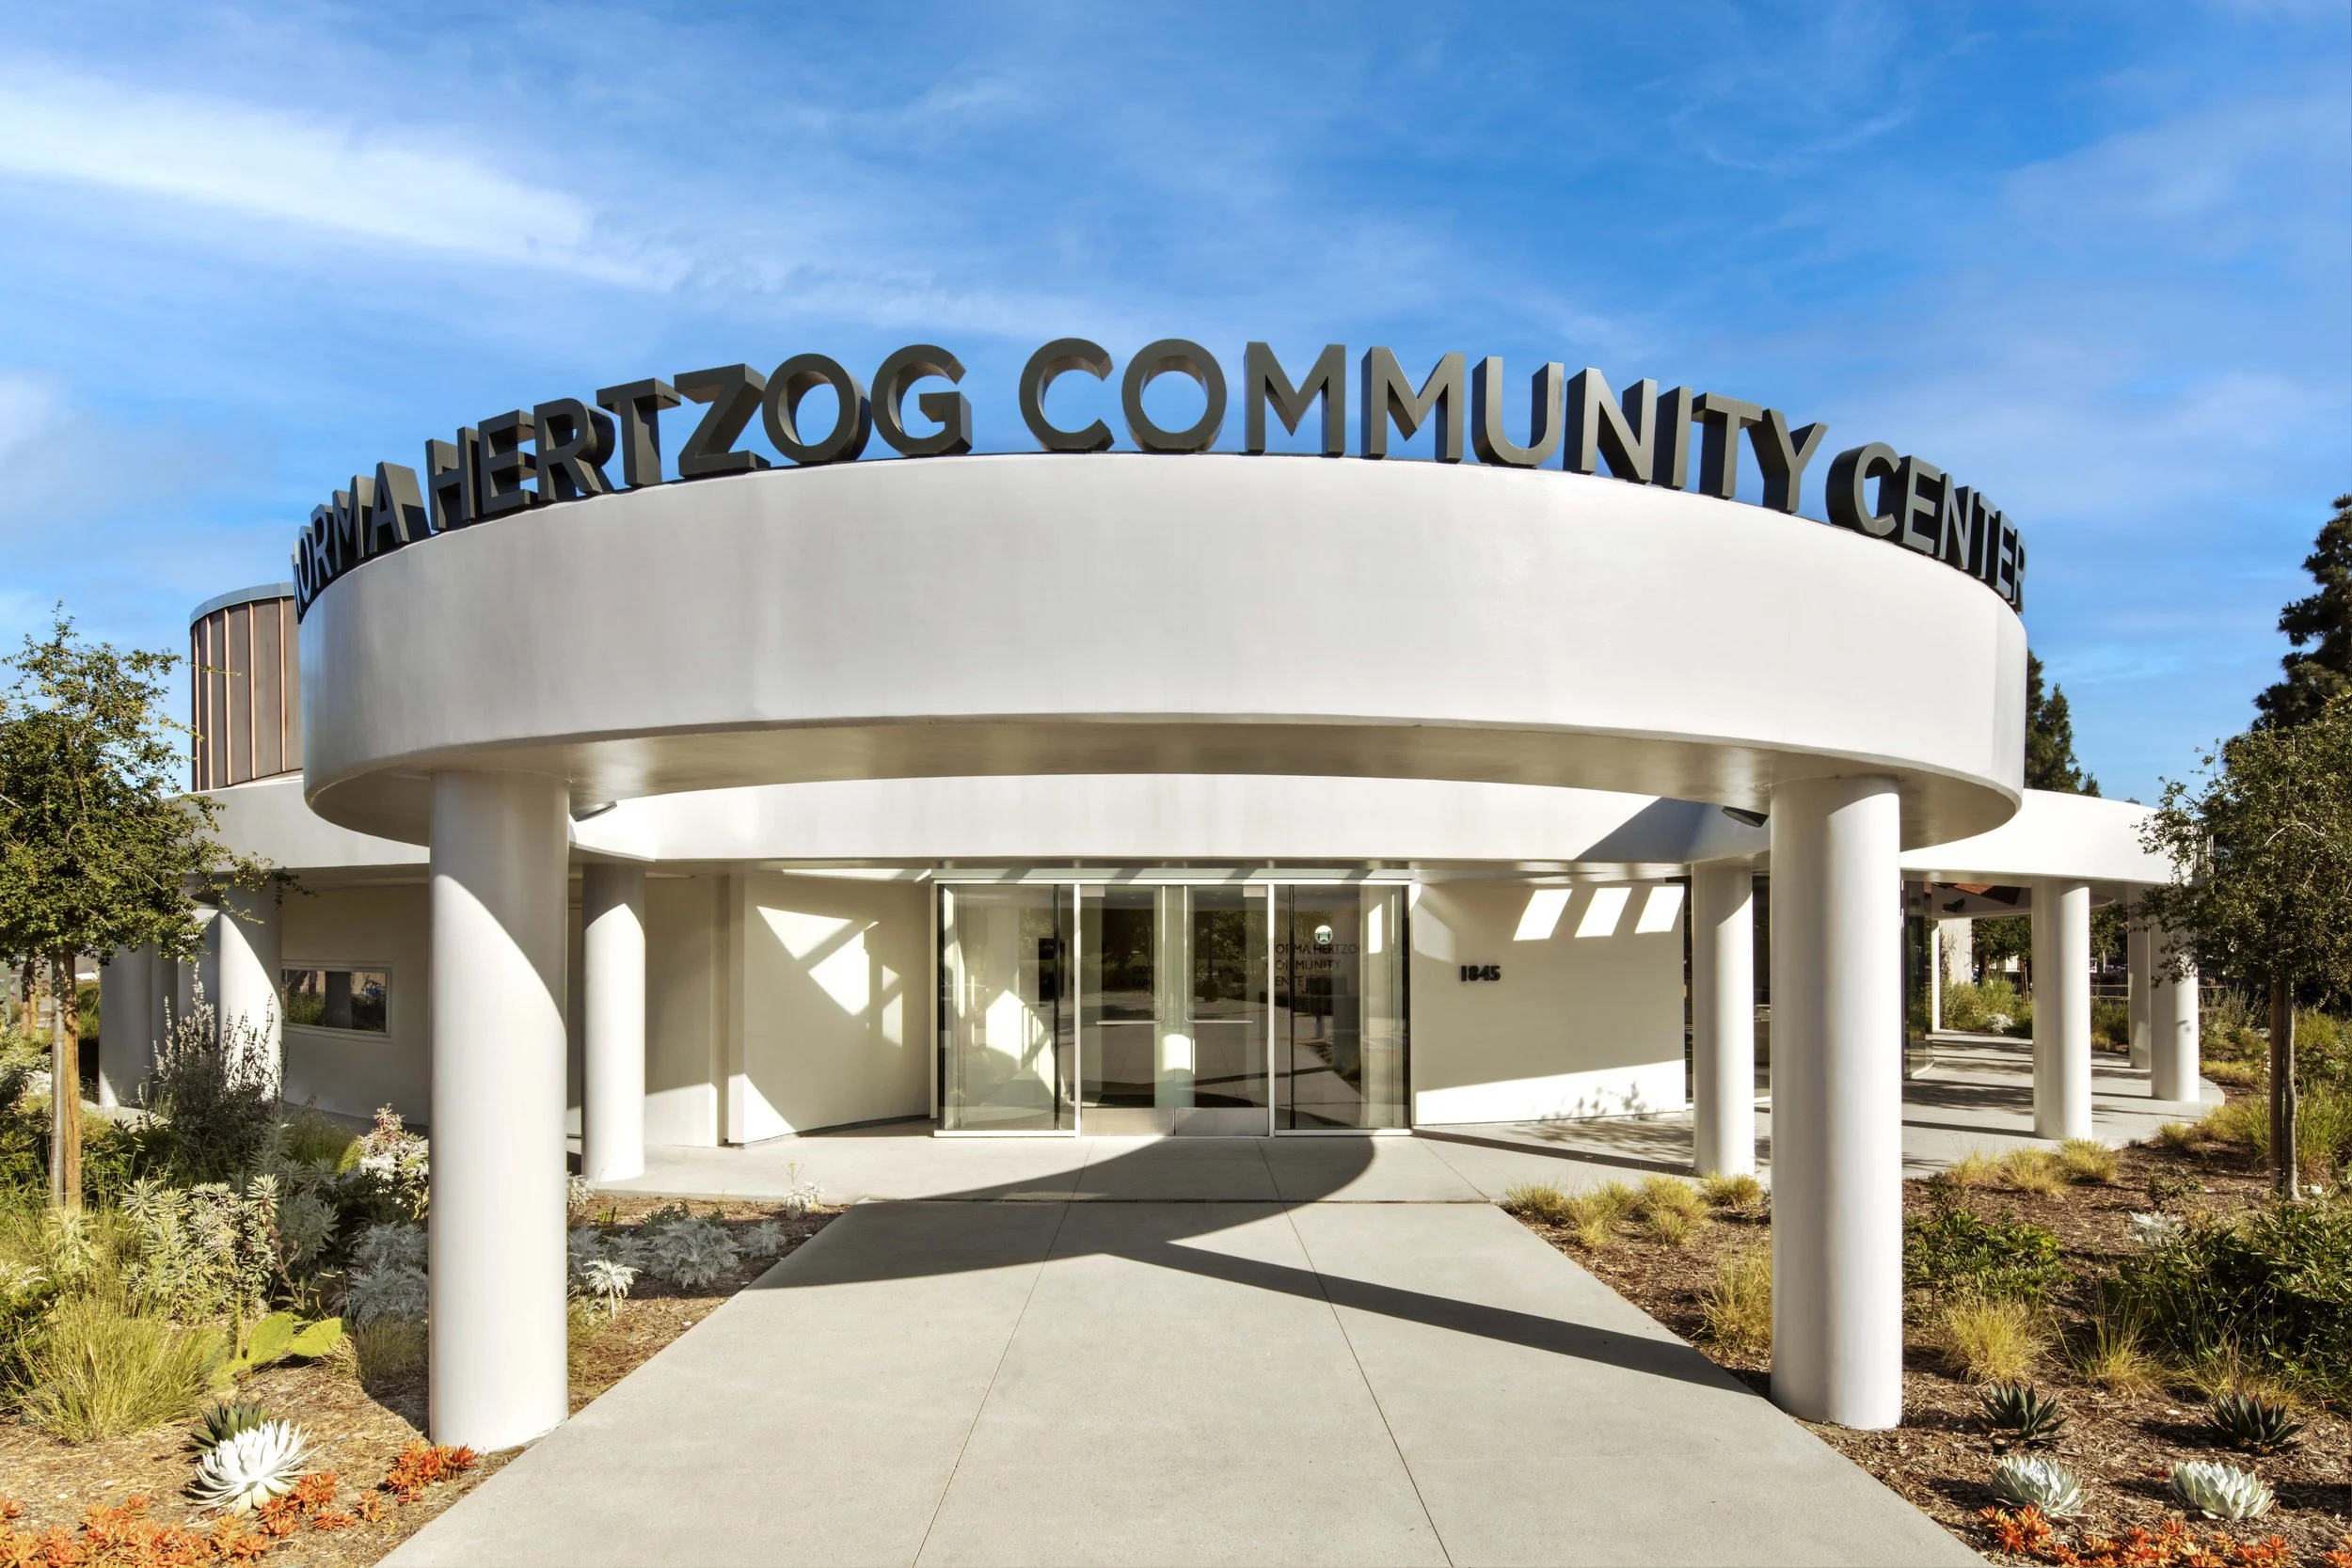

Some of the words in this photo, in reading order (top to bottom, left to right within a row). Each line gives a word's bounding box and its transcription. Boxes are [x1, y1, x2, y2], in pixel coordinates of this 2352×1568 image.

[425, 343, 973, 532] HERTZOG
[1019, 338, 1828, 515] COMMUNITY
[1825, 441, 2027, 615] CENTER
[1461, 965, 1502, 981] 1845
